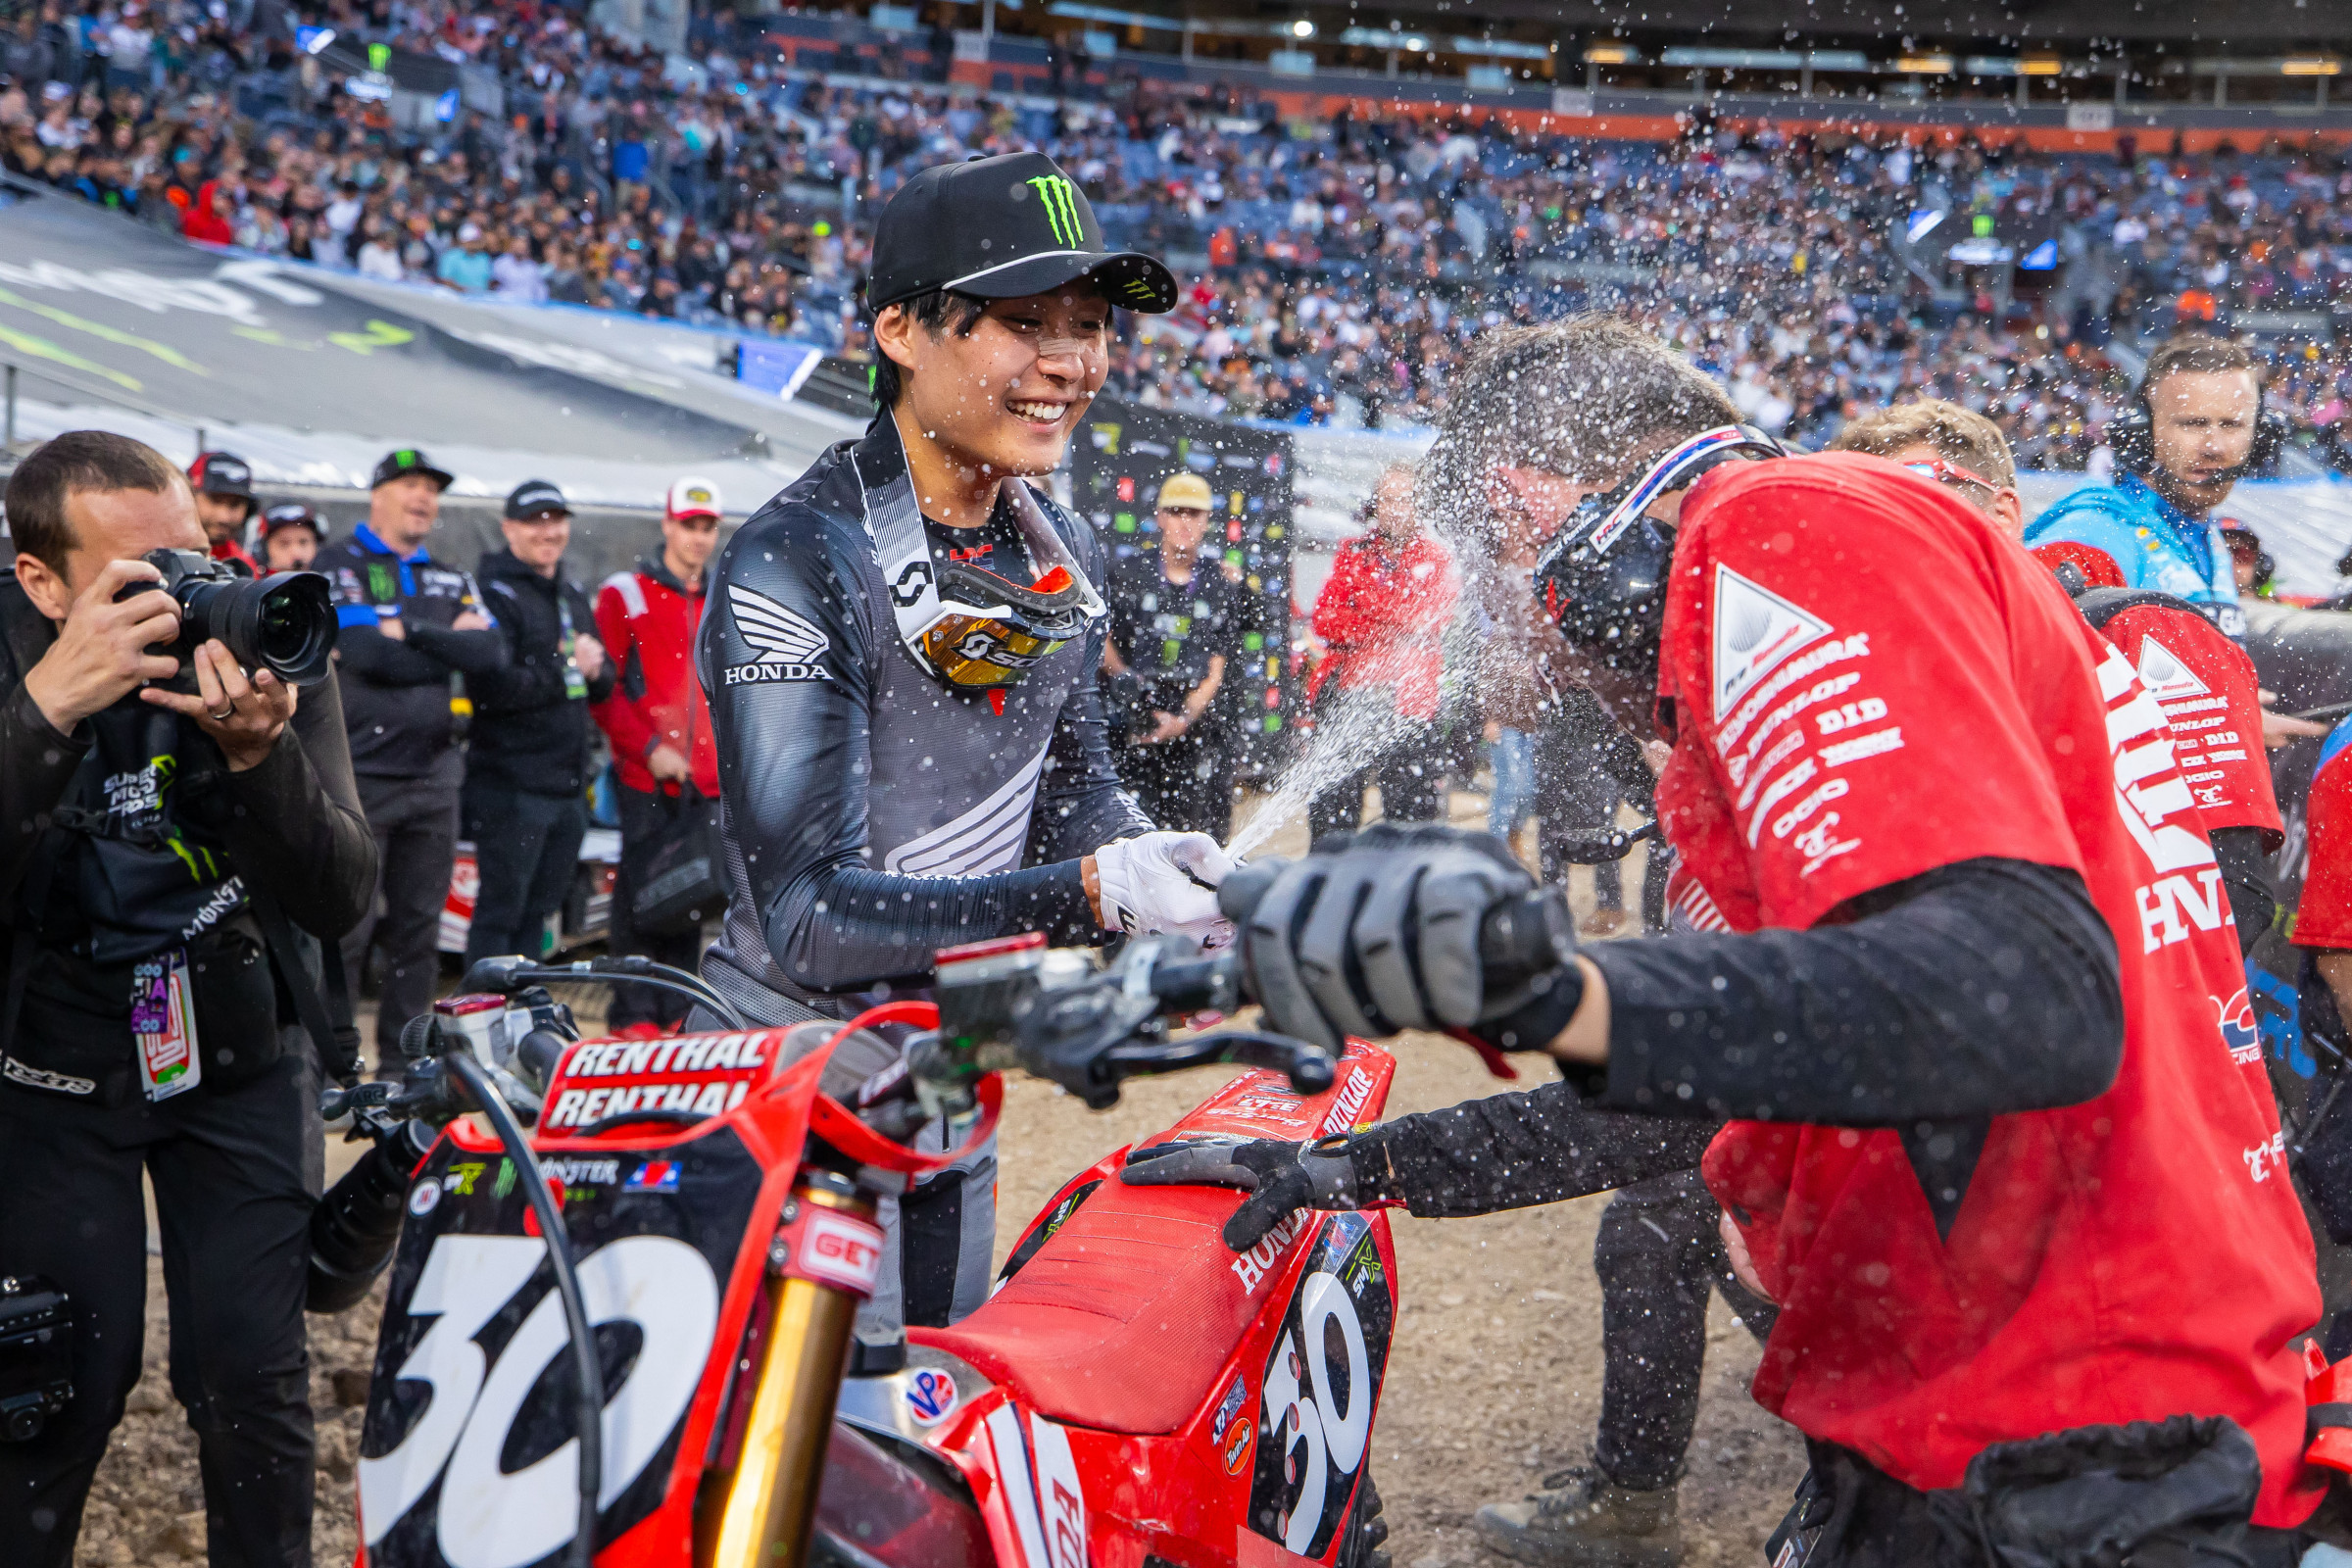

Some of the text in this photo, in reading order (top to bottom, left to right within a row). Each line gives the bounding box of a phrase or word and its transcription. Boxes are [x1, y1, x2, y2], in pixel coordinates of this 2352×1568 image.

[724, 663, 834, 685] HONDA
[1746, 672, 1860, 760] DUNLOP
[1816, 697, 1888, 735] DID
[2162, 696, 2230, 716] SHIMURA
[2170, 716, 2226, 733] UNLOP
[564, 1032, 766, 1078] RENTHAL
[1323, 1064, 1373, 1135] DUNLOP
[539, 1156, 620, 1186] ONSTER
[357, 1233, 719, 1568] 30
[906, 1372, 941, 1416] VP
[1263, 1271, 1371, 1556] 30
